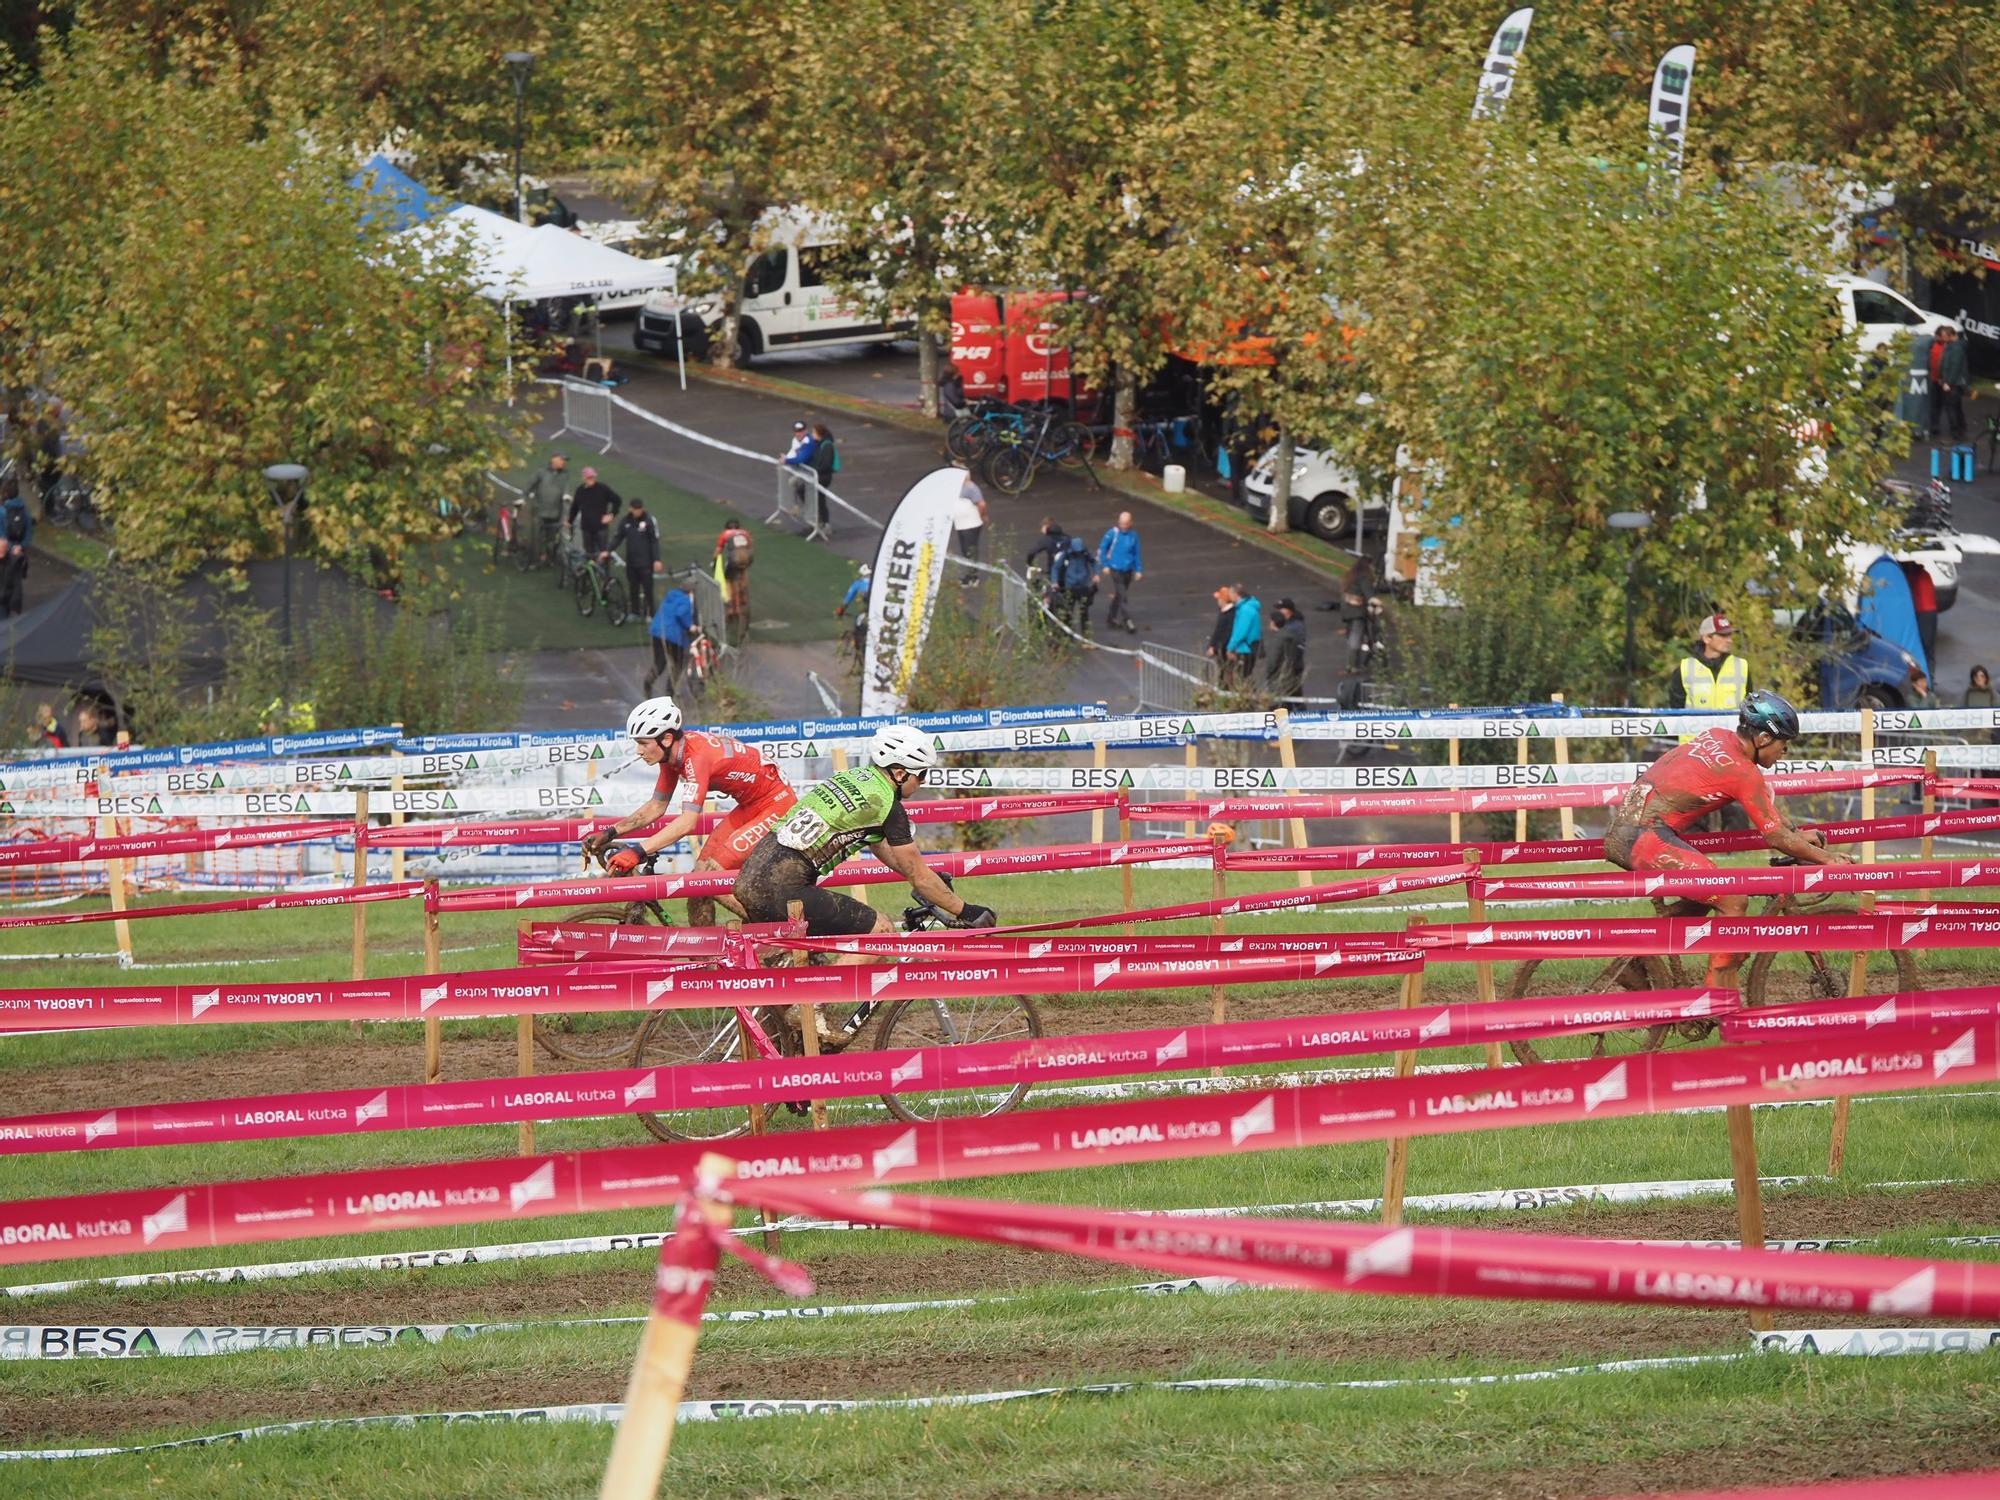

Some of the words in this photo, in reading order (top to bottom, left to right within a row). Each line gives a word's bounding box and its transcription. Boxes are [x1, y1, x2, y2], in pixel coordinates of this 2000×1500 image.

[908, 716, 949, 728] Gipuzkoa
[950, 714, 983, 725] Kirolak
[1002, 710, 1043, 722] Gipuzkoa
[1044, 708, 1076, 719] Kirolak
[764, 725, 798, 736] Kirolak
[815, 722, 857, 734] Gipuzkoa
[858, 719, 890, 731] Kirolak
[1140, 718, 1196, 737] BESA
[1356, 722, 1412, 738] BESA
[1484, 720, 1541, 737] BESA
[1611, 718, 1668, 735] BESA
[284, 738, 324, 750] Gipuzkoa
[326, 733, 357, 746] Kirolak
[436, 737, 478, 749] Gipuzkoa
[480, 736, 512, 748] Kirolak
[1014, 726, 1071, 746] BESA
[192, 746, 234, 760] Gipuzkoa
[234, 742, 266, 754] Kirolak
[549, 744, 604, 762] BESA
[762, 741, 818, 759] BESA
[100, 754, 142, 768] Gipuzkoa
[142, 750, 174, 764] Kirolak
[423, 753, 478, 772] BESA
[296, 763, 352, 782] BESA
[929, 768, 992, 787] BESA
[1072, 768, 1134, 788] BESA
[1214, 768, 1277, 788] BESA
[1356, 767, 1418, 787] BESA
[1496, 765, 1558, 785] BESA
[168, 772, 225, 790] BESA
[1773, 780, 1807, 788] LABORAL
[246, 794, 311, 812] BESA
[392, 791, 458, 810] BESA
[538, 786, 604, 807] BESA
[1022, 800, 1056, 808] LABORAL
[1380, 798, 1416, 806] LABORAL
[1512, 793, 1546, 801] LABORAL
[100, 796, 163, 814] BESA
[1250, 803, 1284, 811] LABORAL
[256, 830, 292, 840] LABORAL
[484, 828, 519, 836] LABORAL
[1830, 826, 1864, 836] LABORAL
[121, 841, 156, 850] LABORAL
[1156, 845, 1194, 854] LABORAL
[1546, 846, 1583, 854] LABORAL
[1010, 854, 1048, 863] LABORAL
[1402, 850, 1439, 859] LABORAL
[1694, 876, 1736, 886] LABORAL
[1852, 872, 1894, 880] LABORAL
[559, 886, 602, 896] LABORAL
[303, 893, 343, 906] LABORAL
[1270, 896, 1310, 908] LABORAL
[1536, 930, 1590, 941] LABORAL
[1752, 925, 1808, 936] LABORAL
[896, 944, 946, 954] LABORAL
[1088, 944, 1138, 952] LABORAL
[1280, 940, 1328, 950] LABORAL
[1162, 959, 1220, 972] LABORAL
[940, 968, 998, 982] LABORAL
[716, 978, 774, 990] LABORAL
[262, 992, 322, 1004] LABORAL
[491, 986, 549, 998] LABORAL
[34, 998, 92, 1010] LABORAL
[1564, 1010, 1630, 1026] LABORAL
[1748, 1015, 1815, 1028] LABORAL
[1302, 1031, 1369, 1048] LABORAL
[1038, 1051, 1106, 1068] LABORAL
[1777, 1056, 1868, 1082] LABORAL
[772, 1072, 840, 1088] LABORAL
[504, 1092, 573, 1108] LABORAL
[1426, 1090, 1518, 1116] LABORAL
[234, 1110, 304, 1126] LABORAL
[1071, 1122, 1164, 1150] LABORAL
[346, 1190, 442, 1216] LABORAL
[76, 1217, 132, 1239] kutxa
[1634, 1269, 1768, 1305] LABORAL
[42, 1326, 159, 1358] BESA
